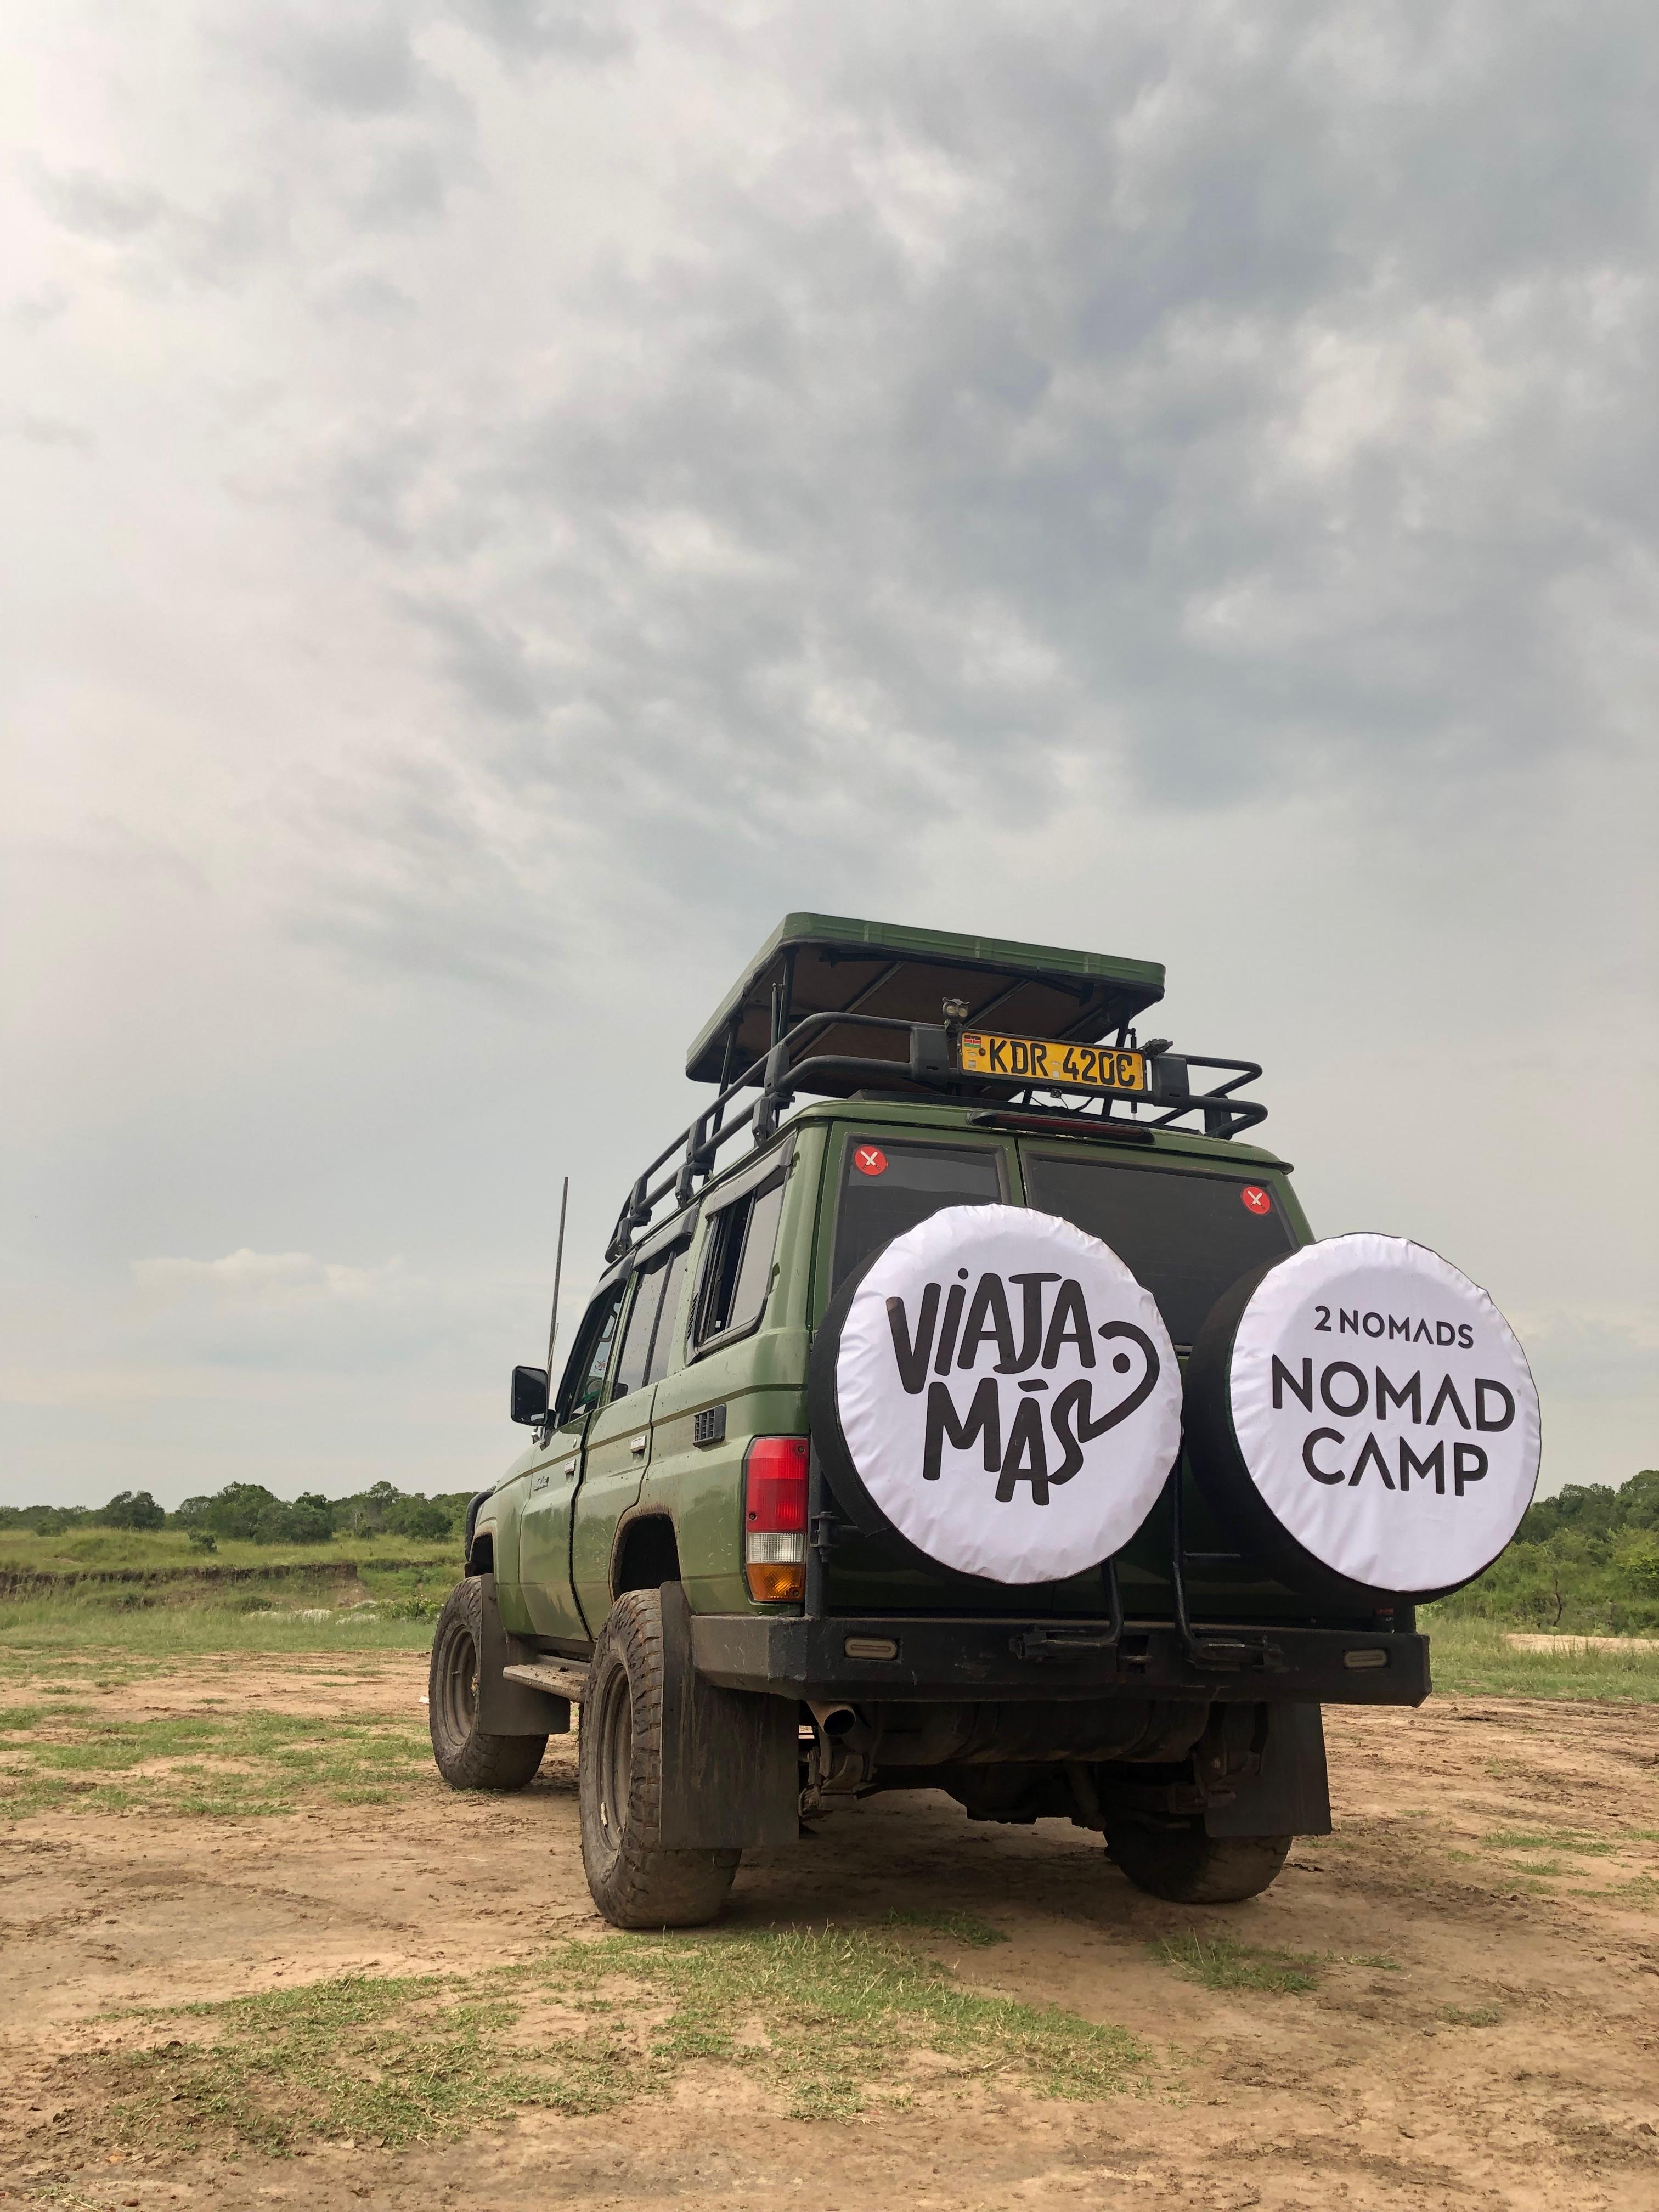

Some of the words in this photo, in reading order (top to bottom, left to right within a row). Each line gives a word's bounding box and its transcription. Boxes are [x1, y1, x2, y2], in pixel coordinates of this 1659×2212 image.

[989, 1038, 1049, 1077] KDR
[1062, 1047, 1135, 1087] 420C
[1271, 1353, 1515, 1432] NOMAD
[1301, 1427, 1488, 1497] CAMP
